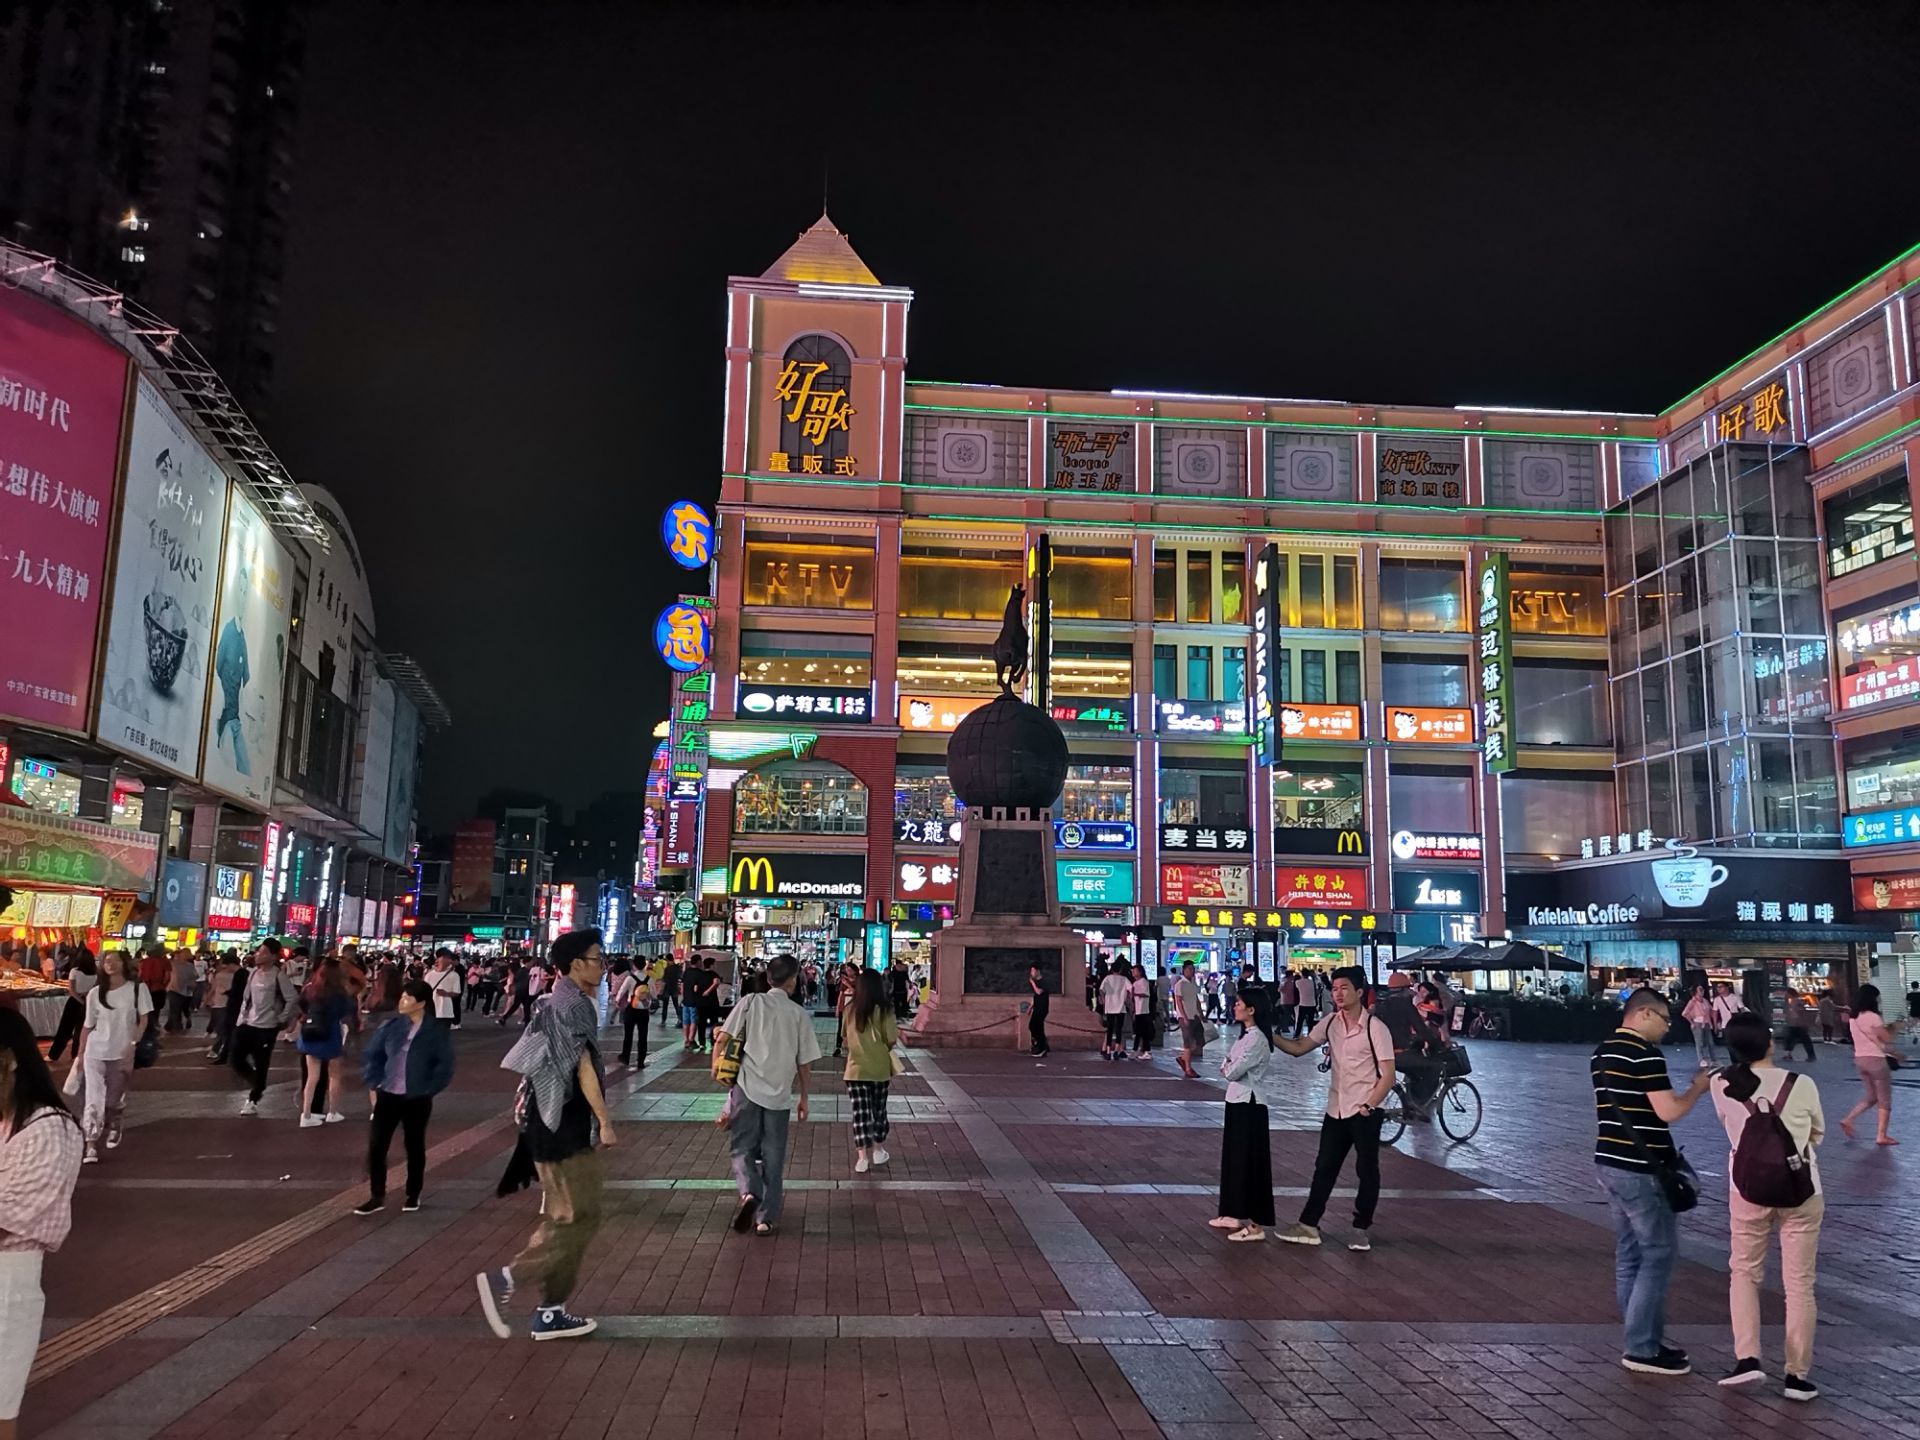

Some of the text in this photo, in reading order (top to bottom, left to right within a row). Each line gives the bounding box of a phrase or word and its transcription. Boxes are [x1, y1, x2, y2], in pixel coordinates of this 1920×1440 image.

[773, 360, 856, 446] 好歌
[1718, 383, 1785, 441] 好歌
[768, 452, 856, 476] 量贩式
[767, 562, 852, 596] KTV
[1511, 590, 1580, 618] KTV
[1481, 630, 1503, 762] 过桥米线
[901, 820, 944, 843] 九龍
[1164, 828, 1247, 849] 麦当劳
[1071, 867, 1107, 875] watsons
[778, 882, 862, 894] McDonald's
[1528, 903, 1640, 925] Kafelaku Coffee
